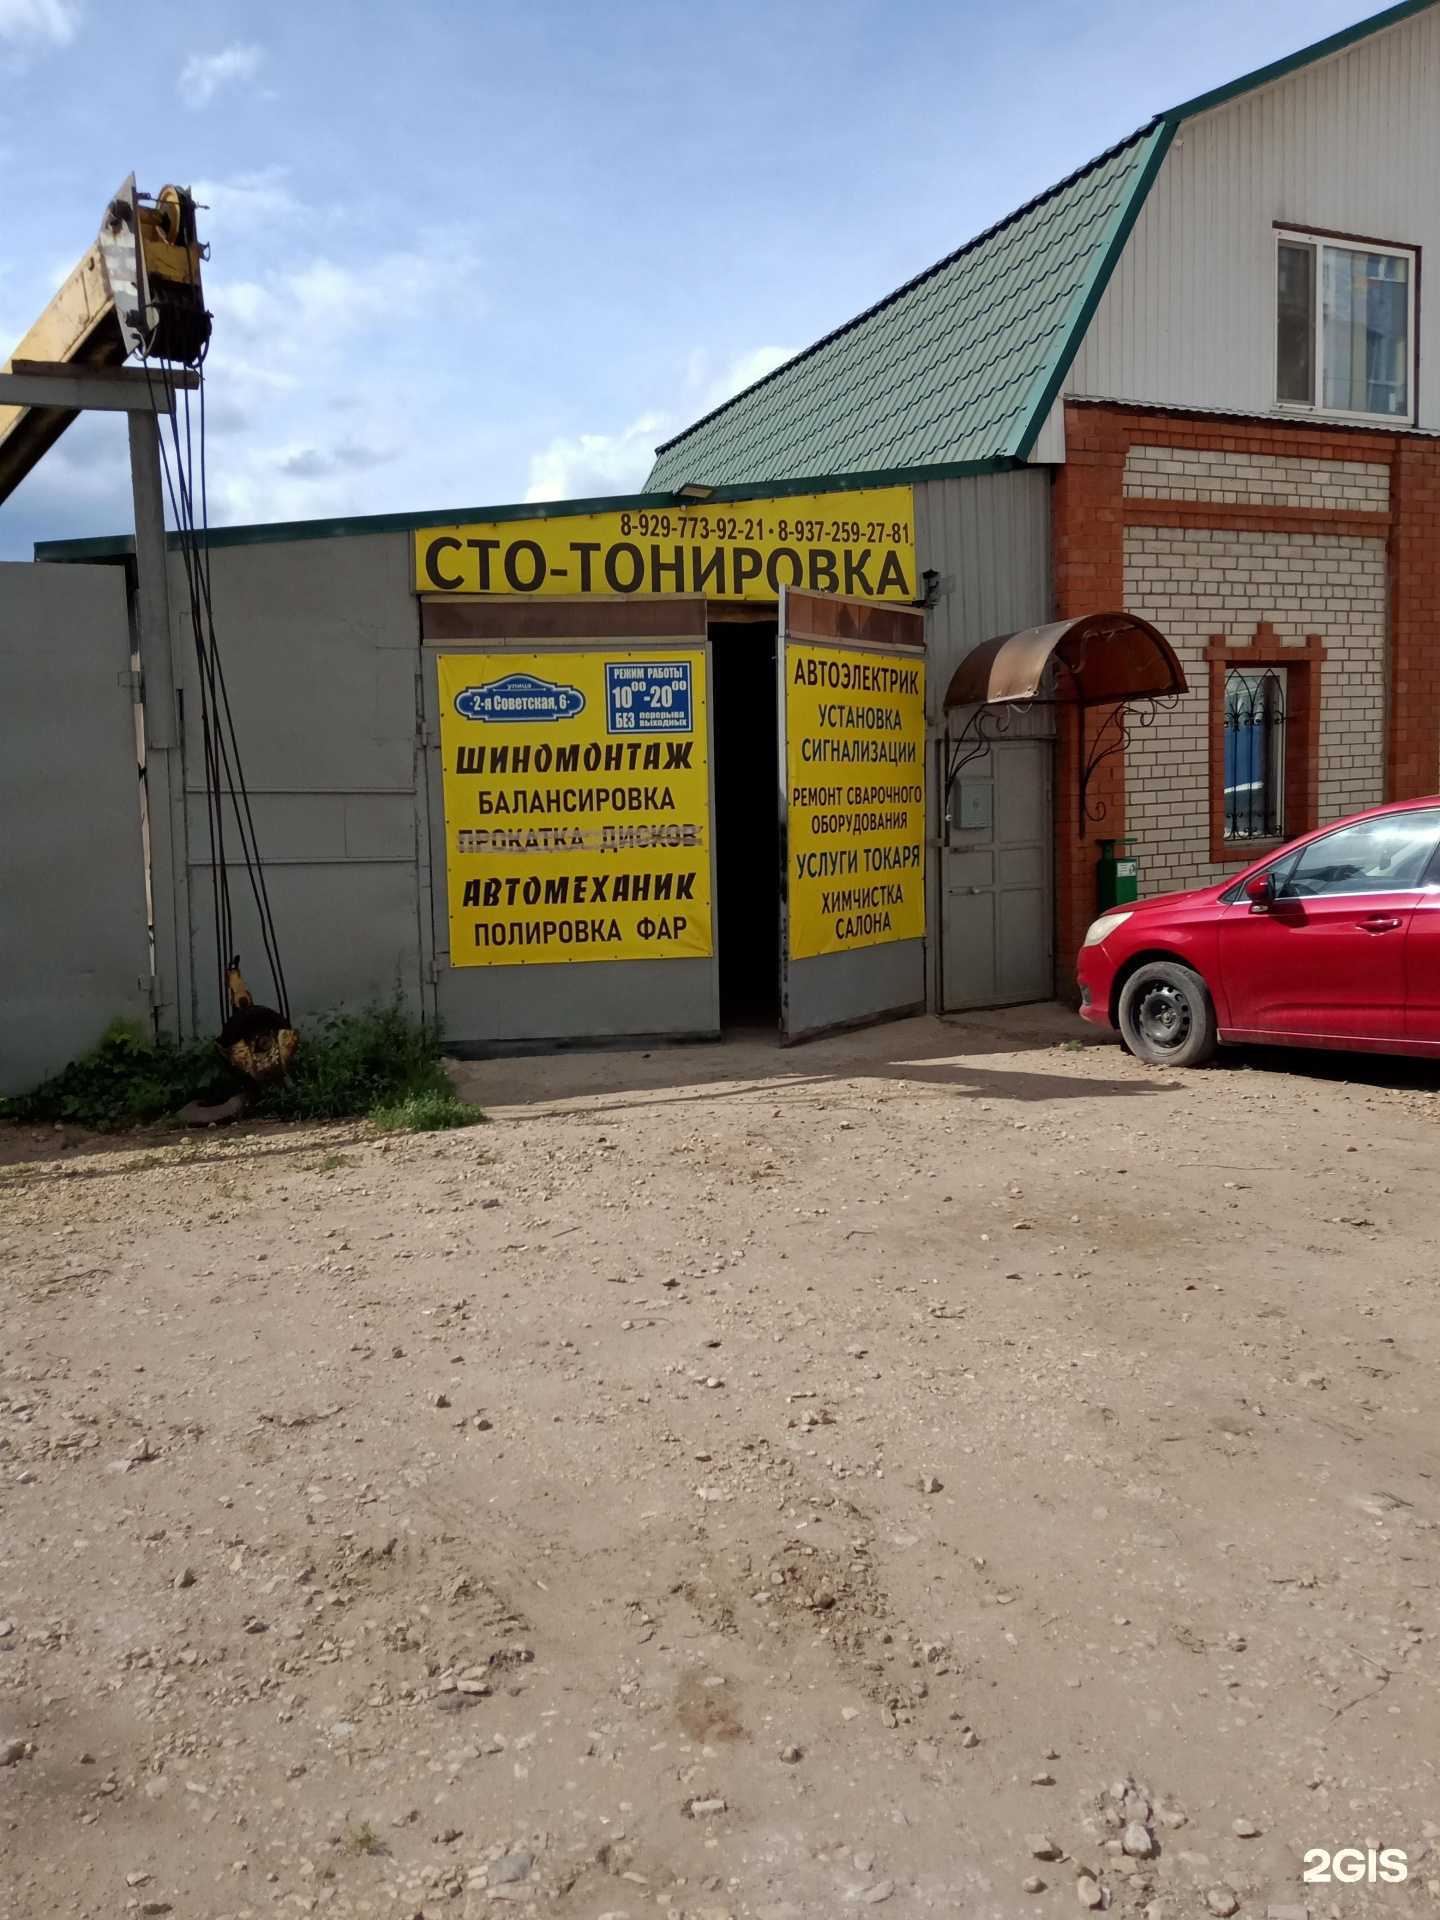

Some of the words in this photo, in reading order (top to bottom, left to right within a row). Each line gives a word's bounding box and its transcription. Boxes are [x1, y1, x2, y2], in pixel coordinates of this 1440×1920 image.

[621, 513, 764, 541] 8-929-773-92-21
[778, 519, 909, 545] 8-937-259-27-81
[425, 536, 910, 597] СТО-ТОНИРОВКА
[614, 668, 644, 679] РЕЖИМ
[648, 667, 683, 679] РАБОТЫ
[794, 659, 919, 695] АВТОЭЛЕКТРИК
[473, 695, 492, 710] 2-я
[494, 695, 557, 710] Советская,
[559, 694, 567, 709] 6
[615, 712, 635, 728] БЕЗ
[818, 704, 902, 730] УСТАНОВКА
[456, 742, 694, 774] ШИНОМОНТАЖ
[802, 738, 916, 766] СИГНАЛИЗАЦИИ
[478, 787, 676, 815] БАЛАНСИРОВКА
[793, 786, 842, 807] РЕМОНТ
[847, 785, 922, 805] СВАРОЧНОГО
[811, 812, 908, 835] ОБОРУДОВАНИЯ
[796, 850, 858, 879] УСЛУГИ
[863, 845, 920, 871] ТОКАРЯ
[463, 872, 697, 907] АВТОМЕХАНИК
[822, 884, 903, 914] ХИМЧИСТКА
[474, 918, 622, 946] ПОЛИРОВКА
[636, 916, 687, 940] ФАР
[835, 912, 891, 939] САЛОНА
